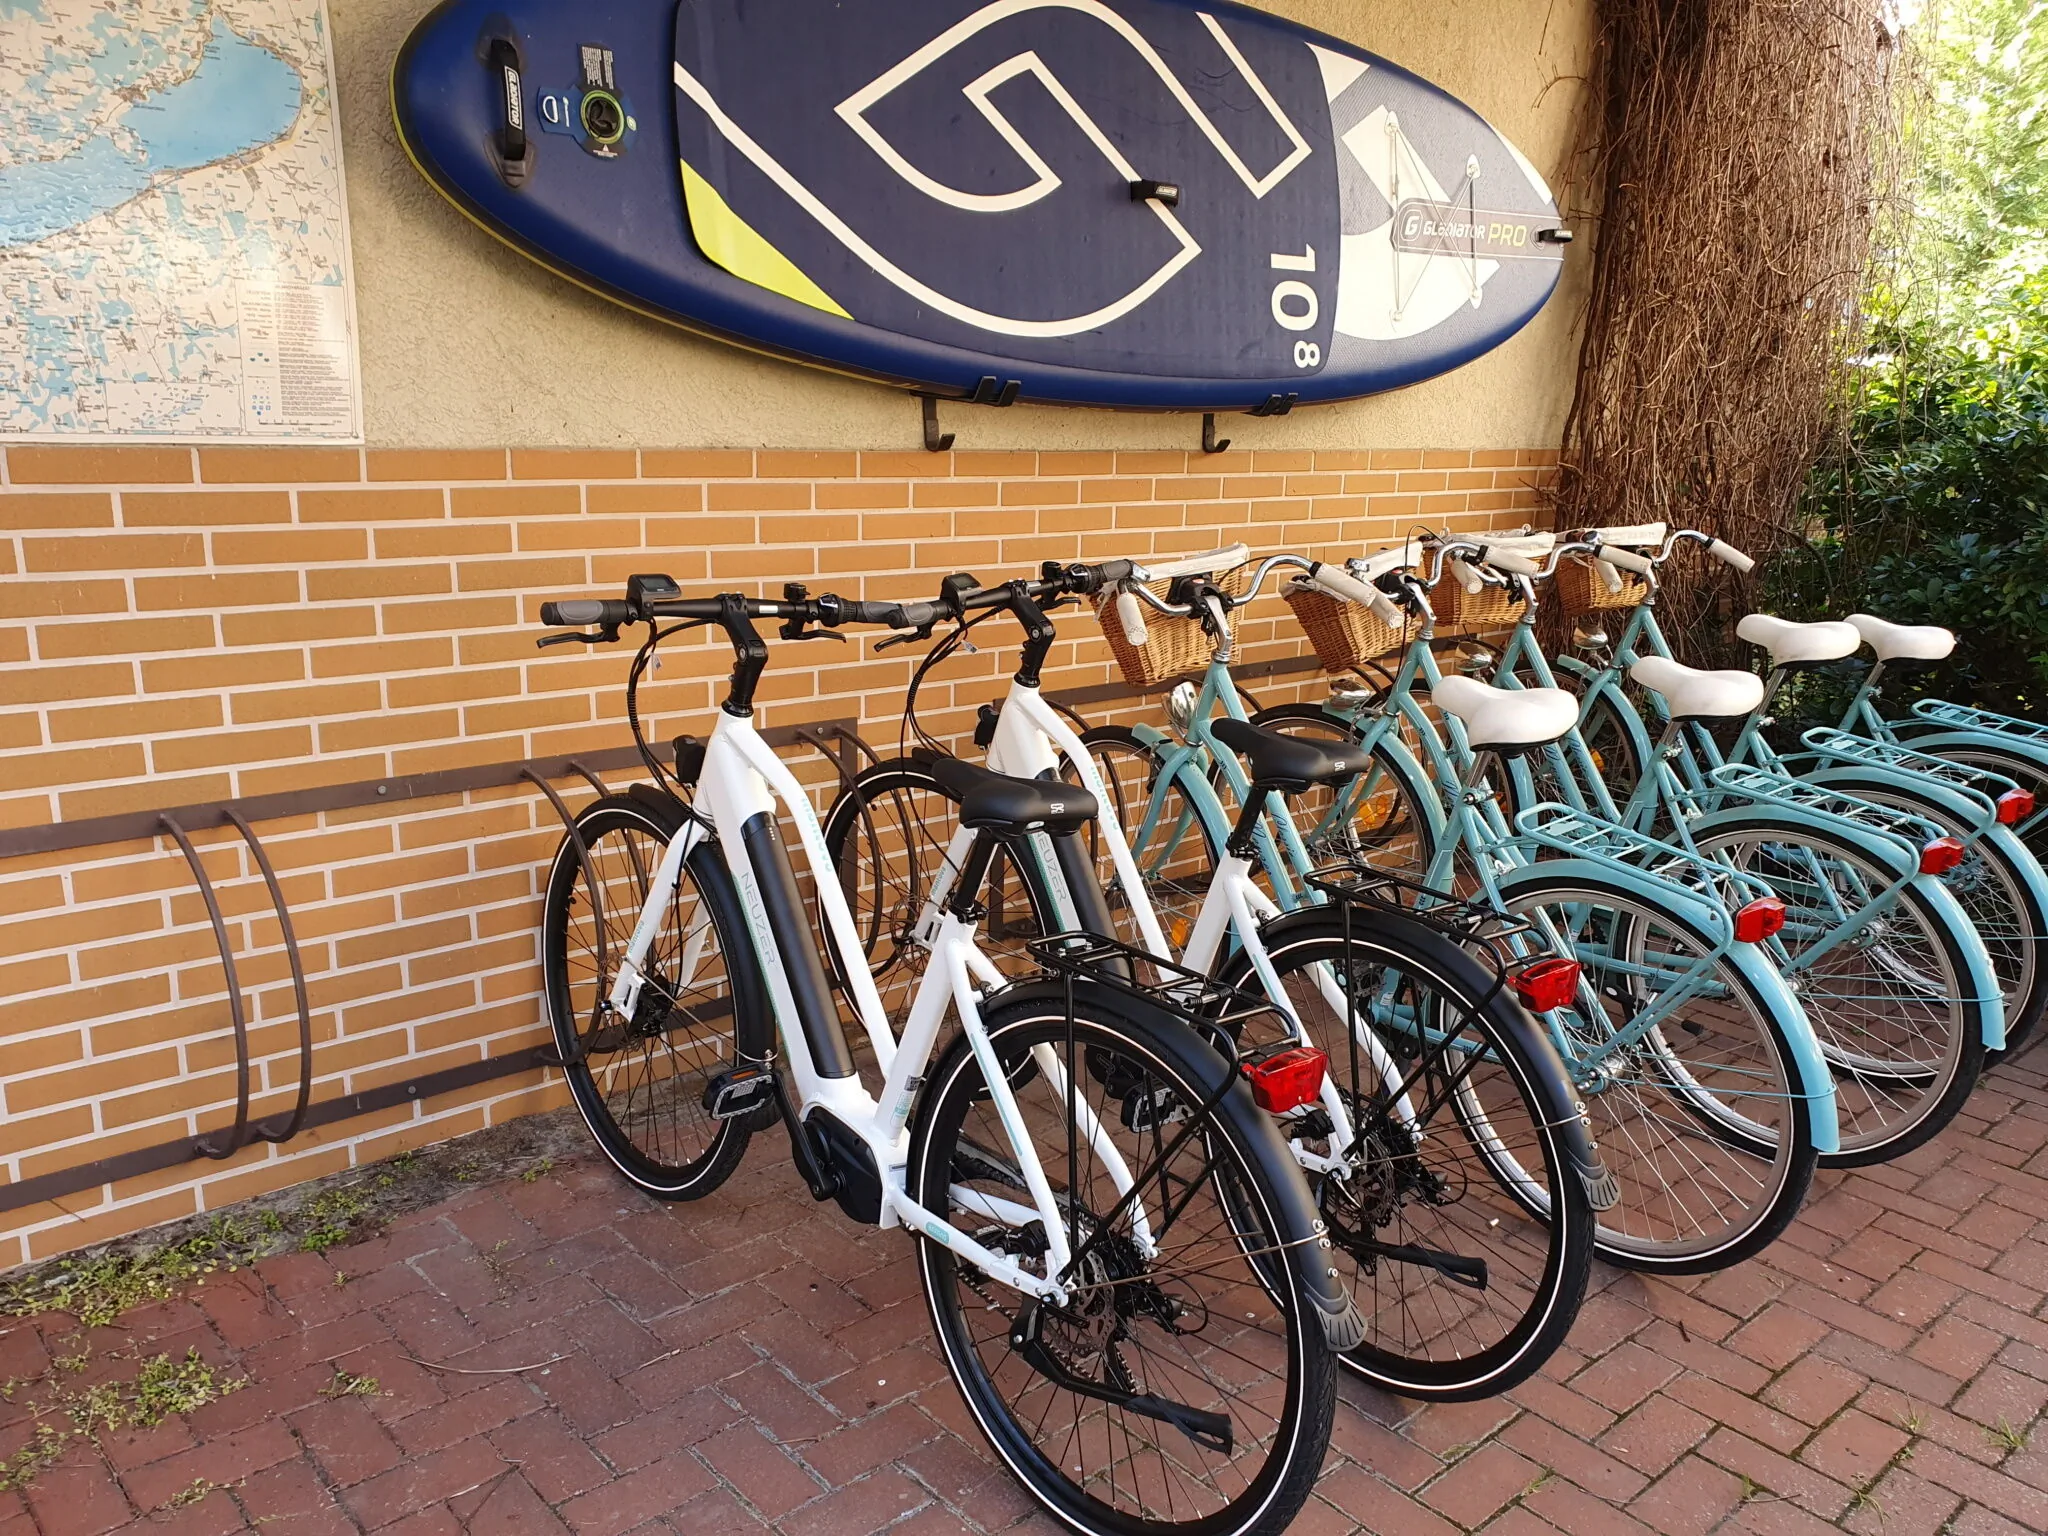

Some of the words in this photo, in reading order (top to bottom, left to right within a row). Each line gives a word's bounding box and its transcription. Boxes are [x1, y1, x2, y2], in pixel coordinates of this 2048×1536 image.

[1487, 223, 1527, 247] PRO
[1270, 243, 1319, 331] 10
[1293, 340, 1320, 368] 8
[741, 872, 776, 965] NEUZER
